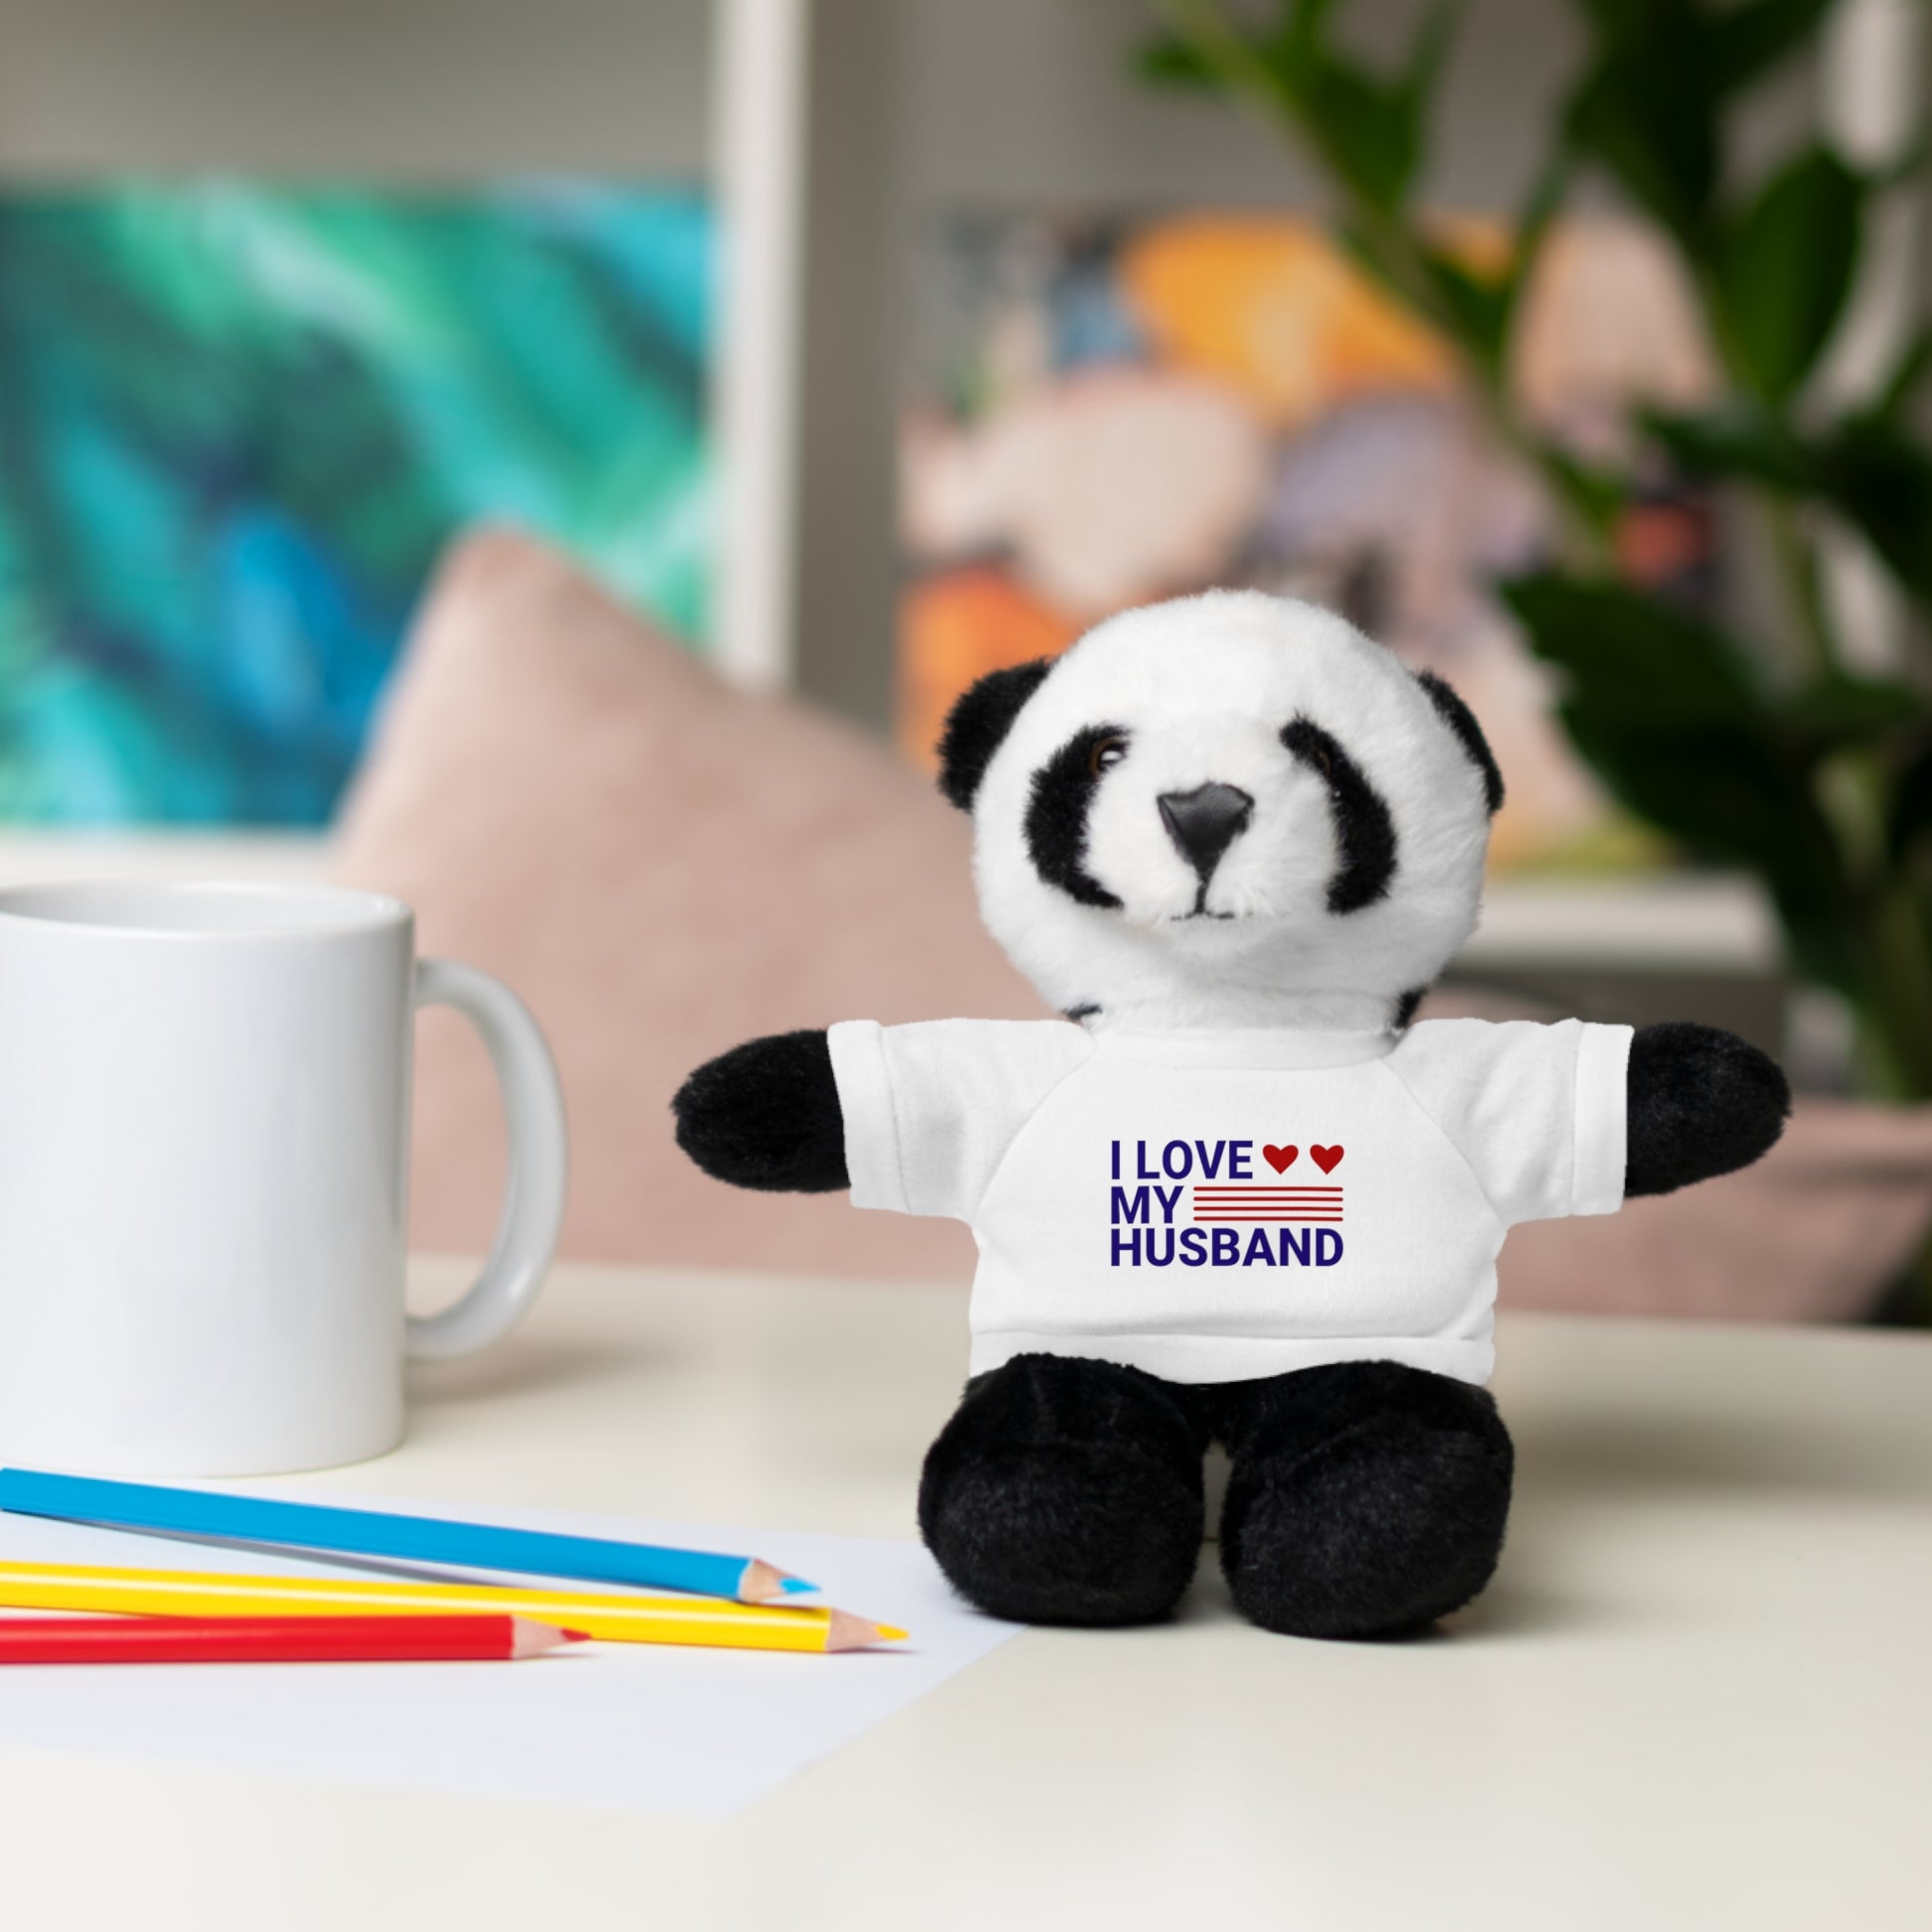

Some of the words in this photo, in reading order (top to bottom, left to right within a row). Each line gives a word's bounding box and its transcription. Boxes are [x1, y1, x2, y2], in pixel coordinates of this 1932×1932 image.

[1111, 1140, 1121, 1180] I
[1137, 1140, 1253, 1180] LOVE
[1111, 1185, 1183, 1224] MY
[1111, 1227, 1344, 1267] HUSBAND
